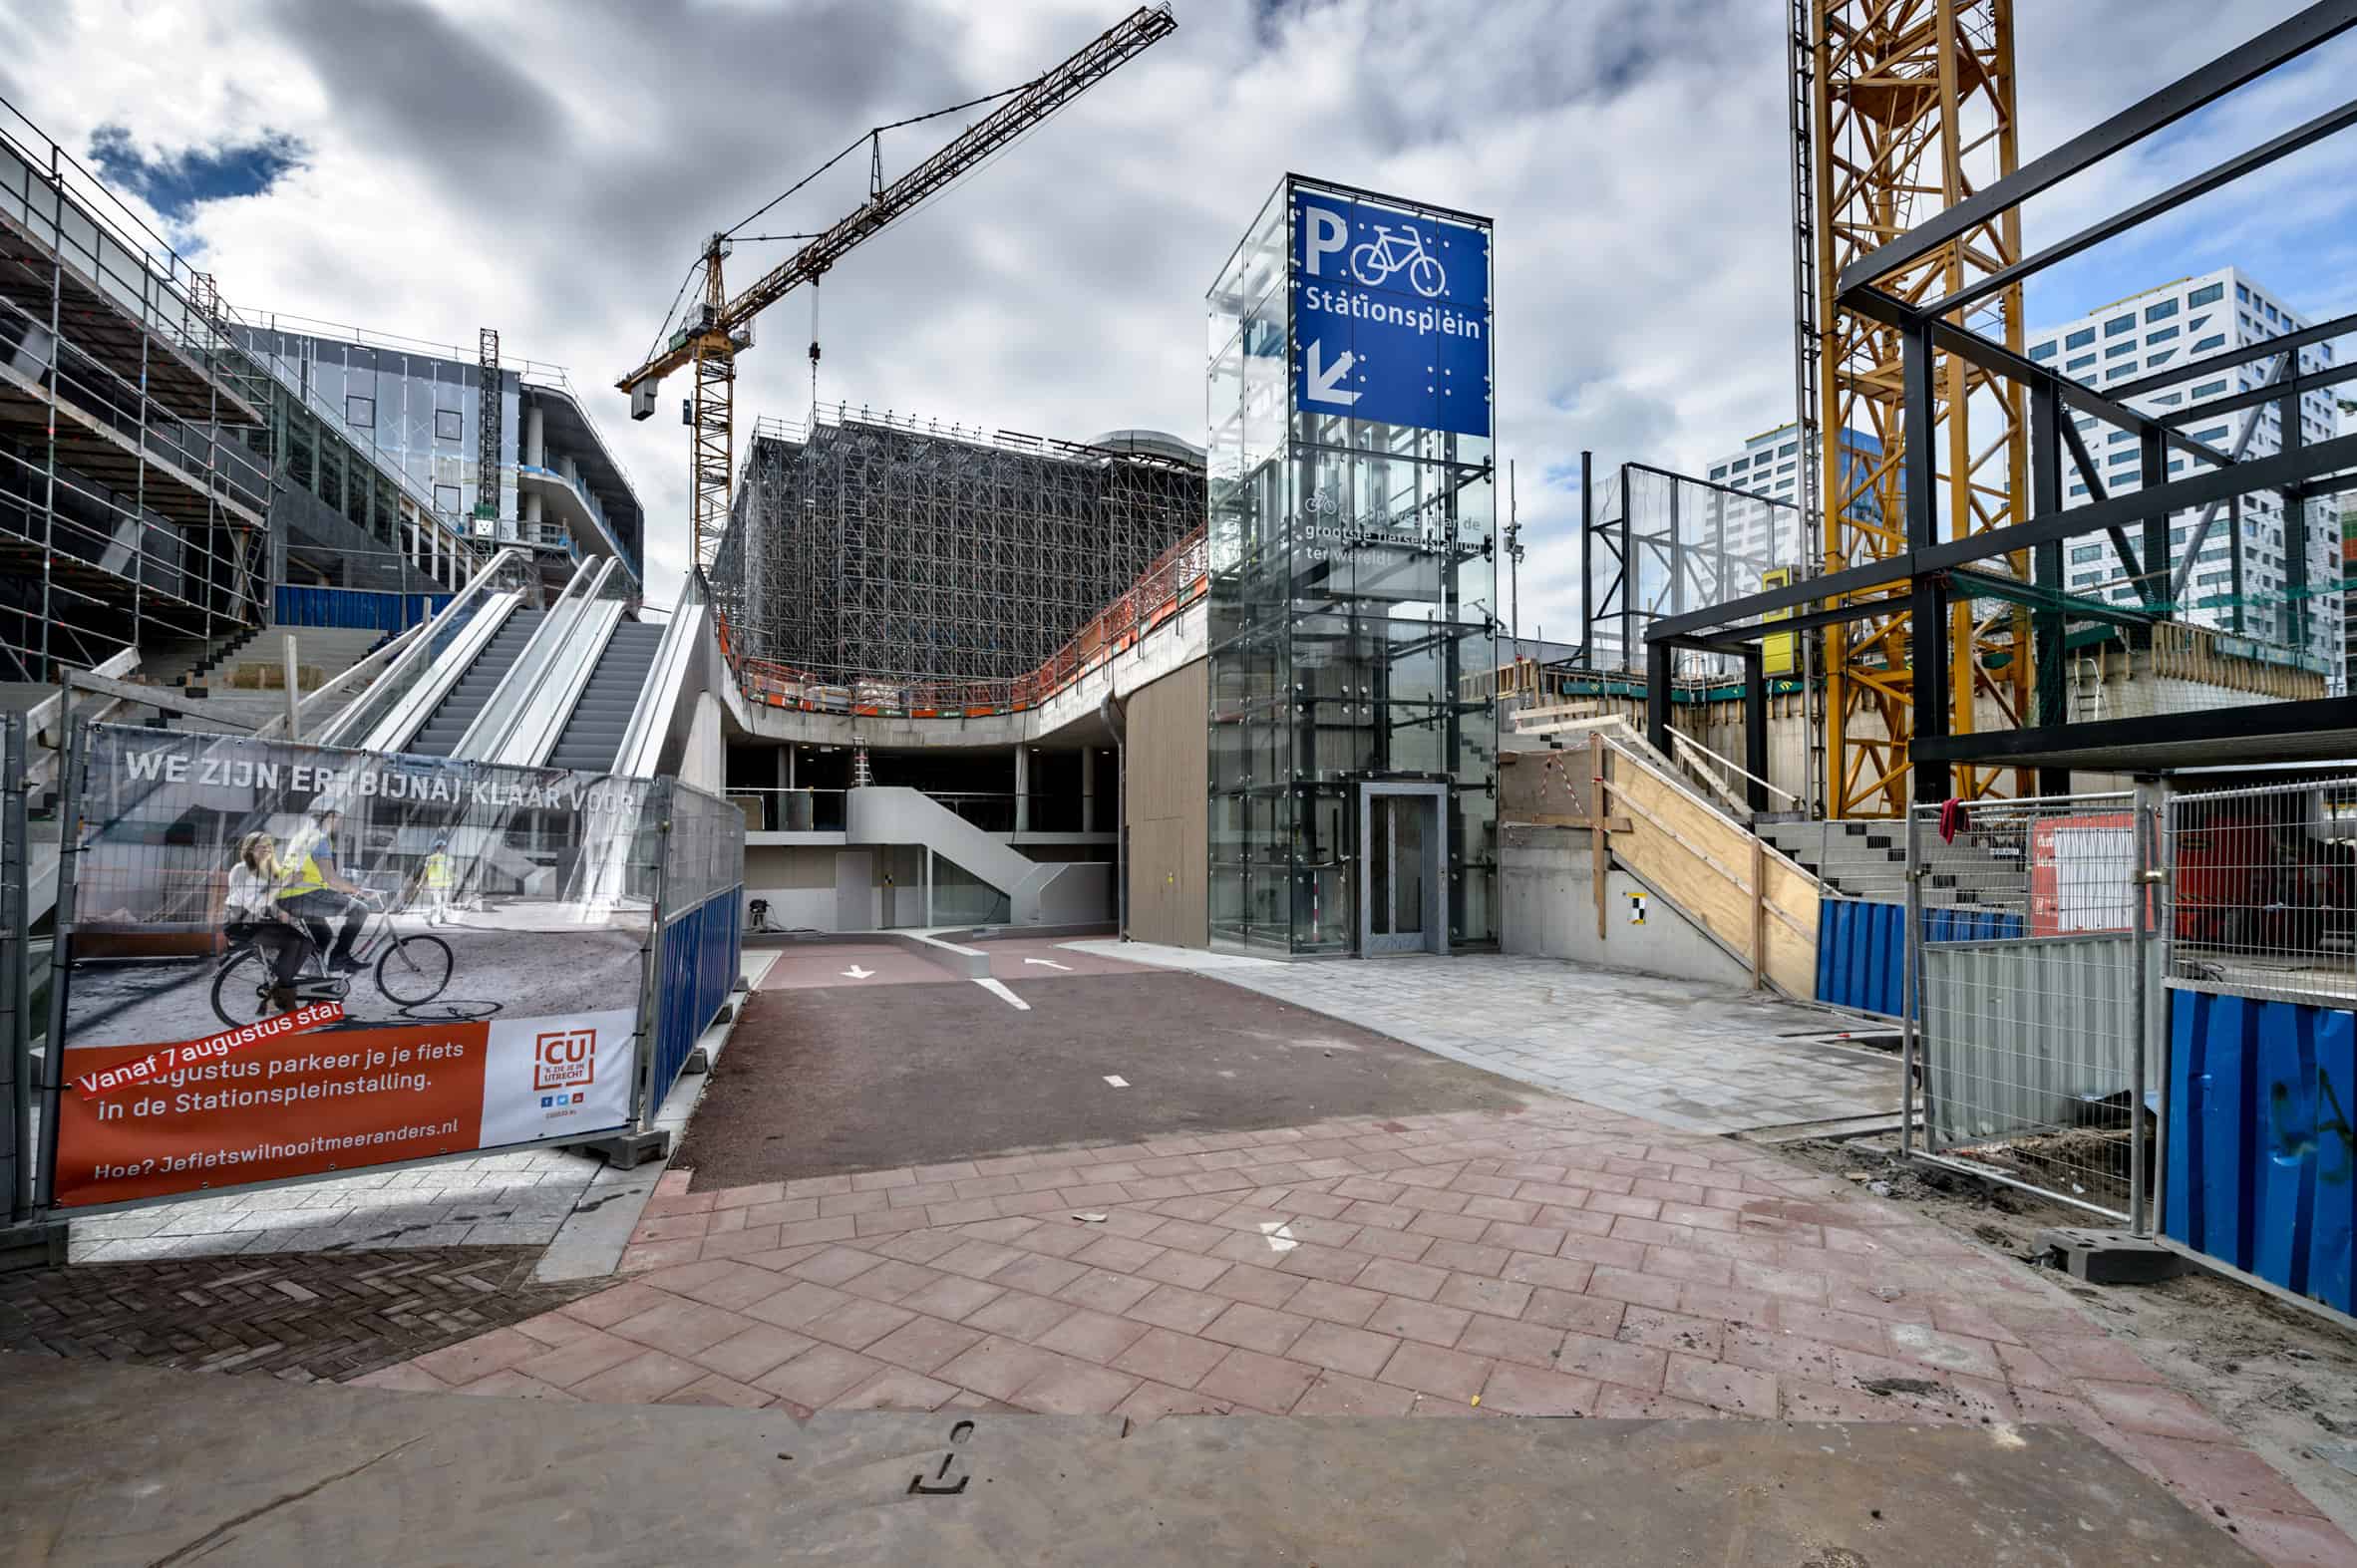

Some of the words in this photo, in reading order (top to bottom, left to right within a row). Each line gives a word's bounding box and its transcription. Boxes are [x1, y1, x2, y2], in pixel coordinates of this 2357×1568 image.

[1306, 205, 1348, 275] P
[1306, 286, 1481, 339] Stationsplein
[1306, 525, 1372, 541] grootste
[1306, 546, 1329, 561] ter
[126, 751, 188, 783] WE
[199, 758, 279, 789] ZIJN
[291, 765, 335, 793] ER
[473, 781, 561, 810] KLAAR
[569, 788, 634, 814] VOOR
[80, 1055, 157, 1093] Vanaf
[162, 1048, 176, 1068] 7
[181, 1018, 292, 1063] augustus
[268, 1052, 360, 1079] parkeer
[366, 1051, 385, 1071] je
[391, 1046, 411, 1067] je
[418, 1041, 464, 1062] fiets
[544, 1038, 586, 1065] CU
[98, 1098, 124, 1121] in
[134, 1096, 167, 1118] de
[175, 1072, 432, 1114] Stationspleinstalling.
[95, 1158, 156, 1181] Hoe?
[160, 1118, 459, 1173] Jefietswilnooitmeeranders.nl
